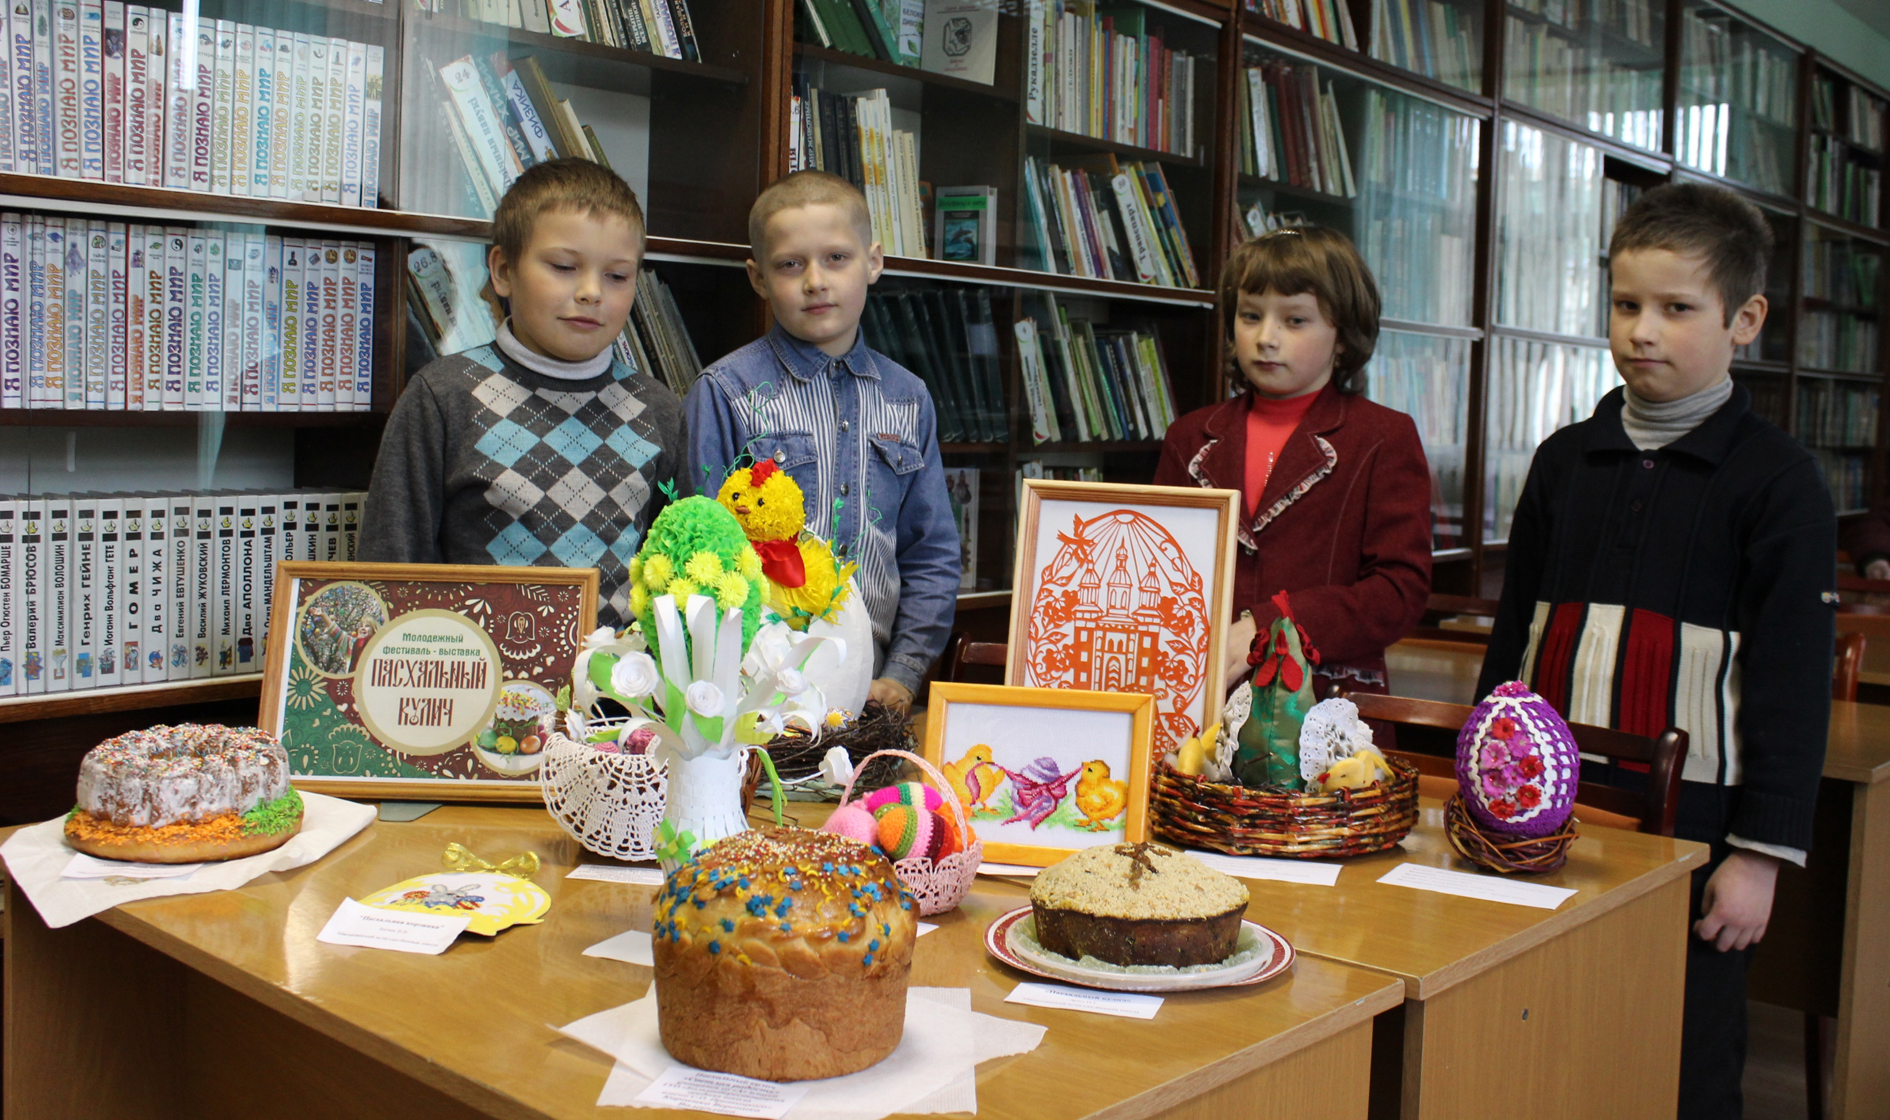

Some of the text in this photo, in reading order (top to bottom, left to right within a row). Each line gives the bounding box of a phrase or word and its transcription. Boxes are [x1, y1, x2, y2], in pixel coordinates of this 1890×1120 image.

[15, 34, 37, 162] Я ПОЗНАЮ МИР
[58, 33, 78, 171] Я ПОЗНАЮ МИР
[83, 35, 101, 171] Я ПОЗНАЮ МИР
[128, 48, 146, 171] Я ПОЗНАЮ МИР
[512, 79, 543, 139] ФИЗИКА
[1029, 27, 1038, 100] Рукадзелле
[193, 64, 212, 183] Я ПОЗНАЮ МИР
[212, 68, 231, 186] Я ПОЗНАЮ МИР
[232, 69, 250, 186] Я ПОЗНАЮ МИР
[254, 68, 271, 185] Я ПОЗНАЮ МИР
[272, 71, 290, 186] Я ПОЗНАЮ МИР
[306, 76, 324, 191] Я ПОЗНАЮ МИР
[324, 77, 342, 192] Я ПОЗНАЮ МИР
[343, 84, 360, 194] Я ПОЗНАЮ МИР
[506, 126, 530, 161] МИР
[414, 251, 438, 272] 26.8
[1126, 203, 1147, 264] Транспарт
[3, 252, 20, 391] Я ПОЗНАЮ МИР
[30, 260, 44, 388] Я ПОЗНАЮ МИР
[46, 263, 63, 389] Я ПОЗНАЮ МИР
[90, 269, 105, 306] МИР
[110, 270, 125, 391] Я ПОЗНАЮ МИР
[148, 270, 162, 390] Я ПОЗНАЮ МИР
[166, 266, 184, 392] Я ПОЗНАЮ МИР
[188, 272, 203, 393] Я ПОЗНАЮ МИР
[206, 272, 220, 392] Я ПОЗНАЮ МИР
[244, 279, 260, 396] Я ПОЗНАЮ МИР
[282, 279, 299, 394] Я ПОЗНАЮ МИР
[302, 281, 320, 394] Я ПОЗНАЮ МИР
[320, 276, 337, 392] Я ПОЗНАЮ МИР
[338, 276, 355, 392] Я ПОЗНАЮ МИР
[360, 282, 372, 314] МИР
[88, 380, 103, 393] Я
[89, 309, 104, 376] ПОЗНАЮ
[357, 382, 370, 393] Я
[358, 318, 371, 378] ПОЗНАЮ
[0, 546, 13, 652] Пьер Огюстен БОМАРШЕ
[26, 546, 38, 649] Валерий БРЮСОВ
[55, 544, 64, 646] Максимилиан ВОЛОШИН
[80, 544, 92, 646] Генрих ГЕЙНЕ
[104, 545, 116, 646] Иоганн Вольфганг ГЕТЕ
[129, 548, 138, 629] ГОМЕР
[152, 549, 162, 634] Два ЧИЖА
[176, 540, 186, 638] Евгений ЕВТУШЕНКО
[198, 542, 208, 638] Василий ЖУКОВСКИЙ
[222, 539, 230, 636] Михаил ЛЕРМОНТОВ
[242, 539, 252, 636] Два АПОЛЛОНА
[264, 536, 273, 605] МАНДЕЛЬШТАМ
[371, 657, 488, 690] ПАСХАЛЬНЫЙ
[402, 632, 464, 643] Молодежный
[438, 648, 480, 657] выставка
[398, 697, 454, 726] КУЛИЧ
